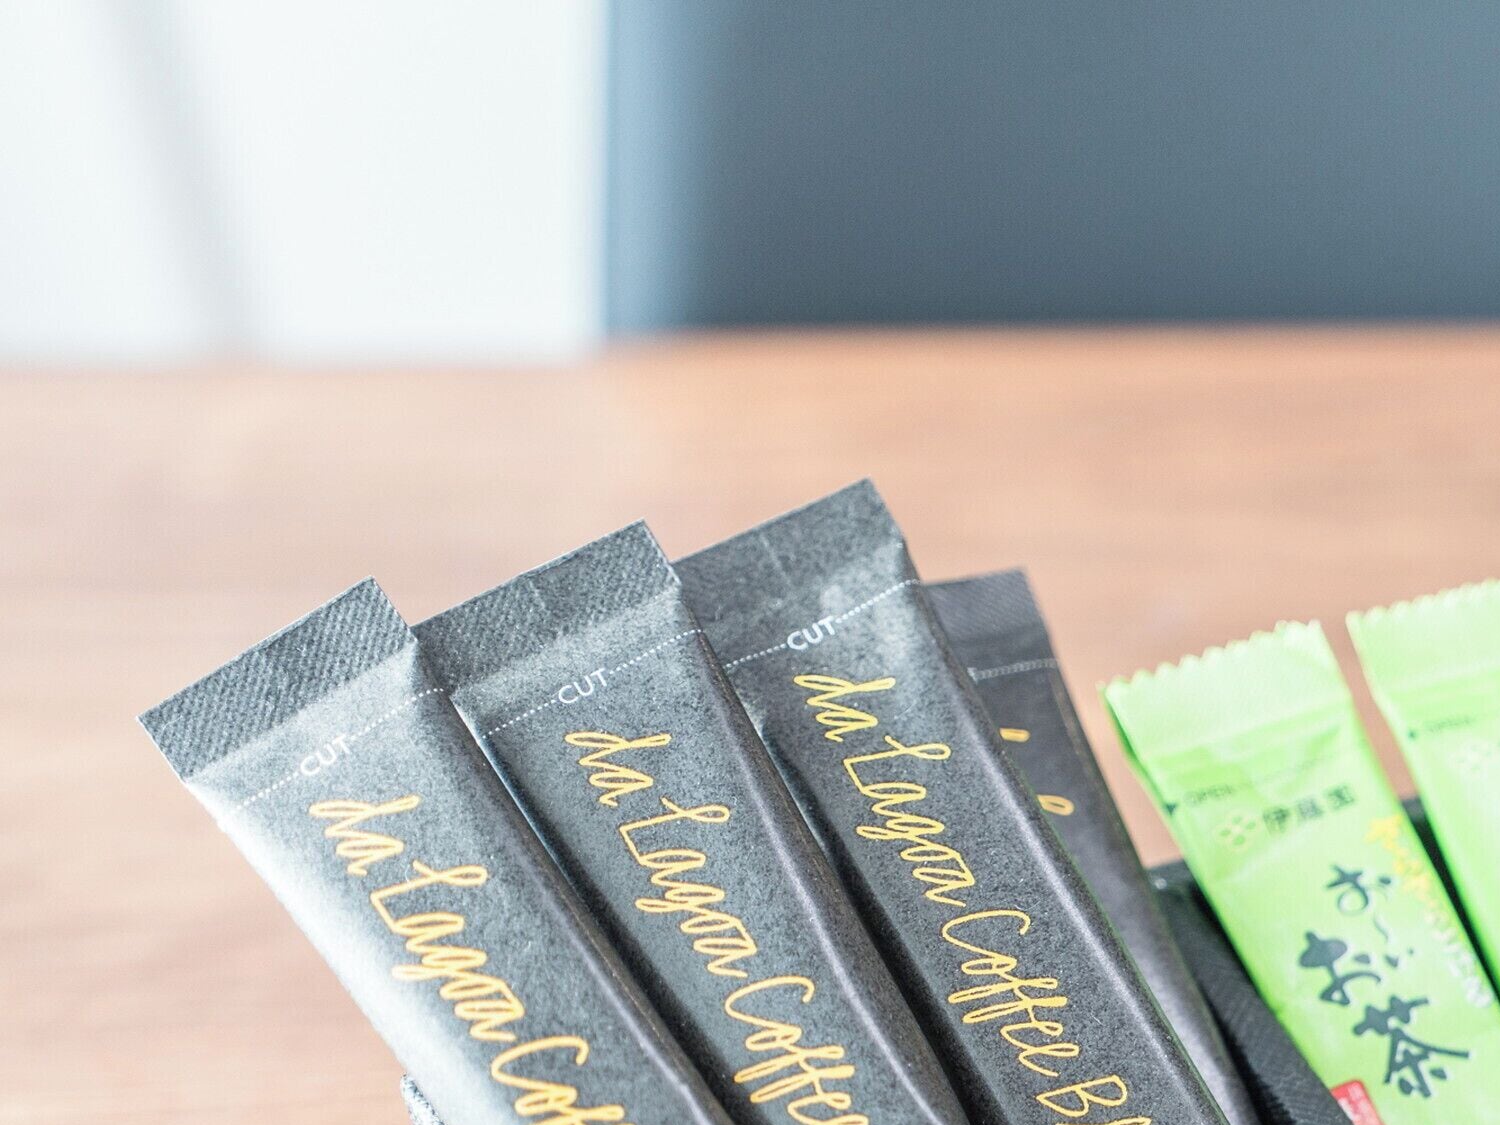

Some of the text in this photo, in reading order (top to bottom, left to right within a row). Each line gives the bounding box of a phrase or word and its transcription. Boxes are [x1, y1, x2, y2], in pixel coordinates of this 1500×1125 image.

[557, 667, 609, 706] CUT
[786, 615, 836, 652] CUT
[300, 734, 352, 778] CUT
[619, 797, 758, 977] Lagoa
[843, 736, 975, 907] Lagoa
[941, 910, 1079, 1078] Coffee
[370, 859, 525, 1043] Lagoa
